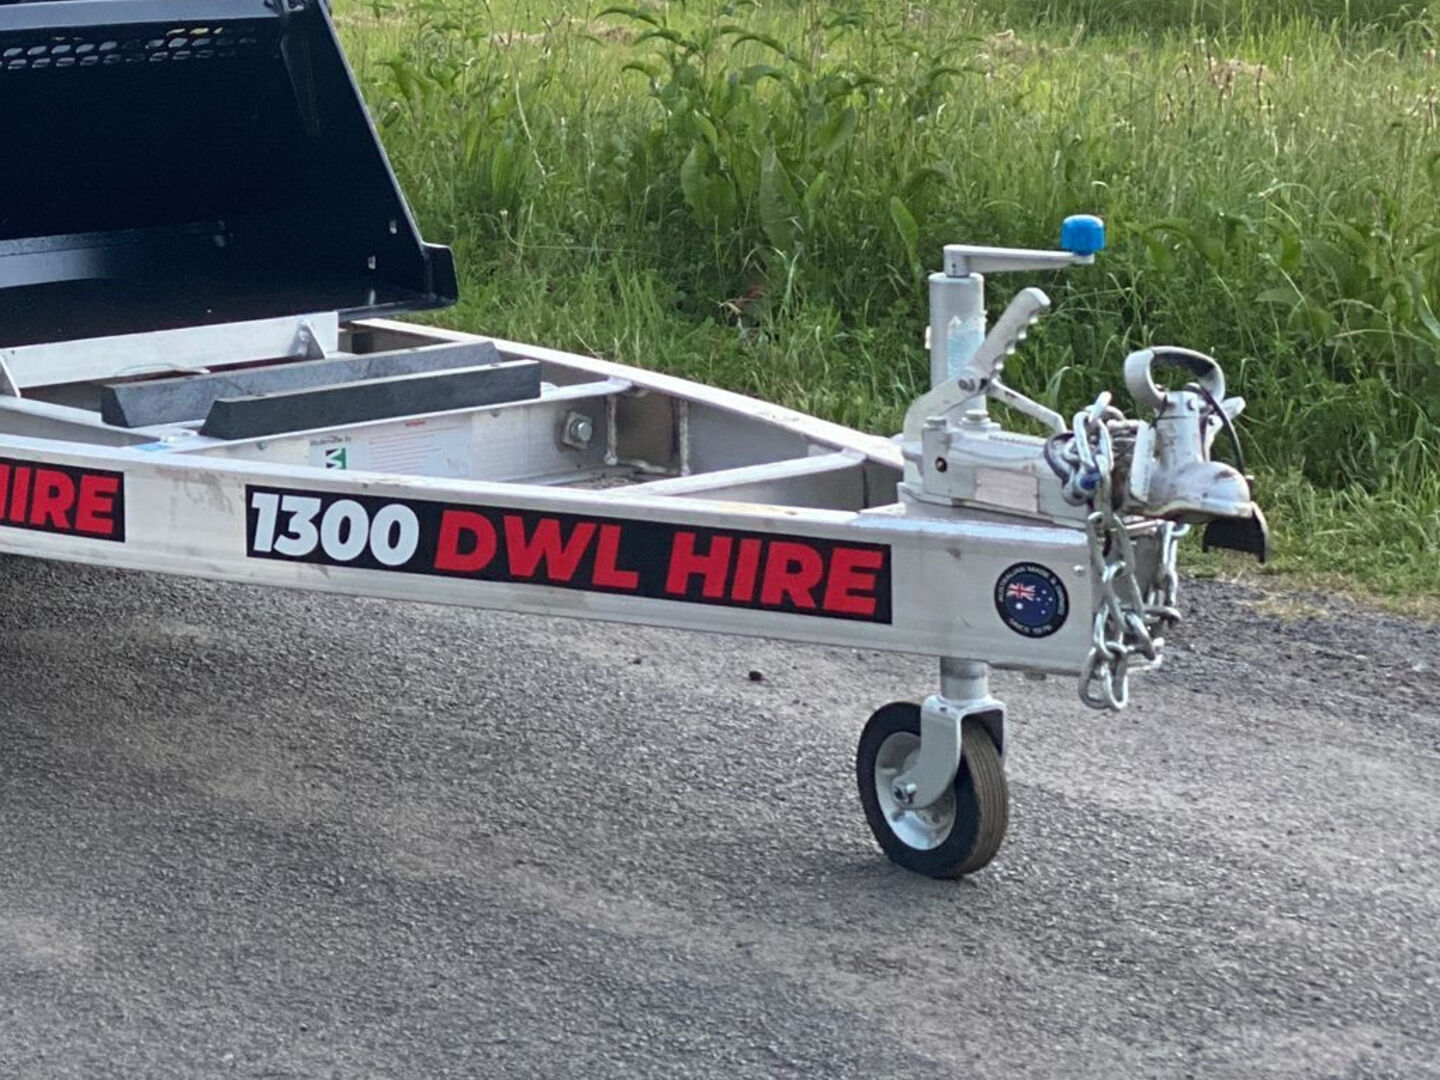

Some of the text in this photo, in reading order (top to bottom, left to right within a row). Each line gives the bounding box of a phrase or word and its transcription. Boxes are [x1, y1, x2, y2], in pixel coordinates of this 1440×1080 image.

[251, 492, 883, 614] 1300 DWL HIRE
